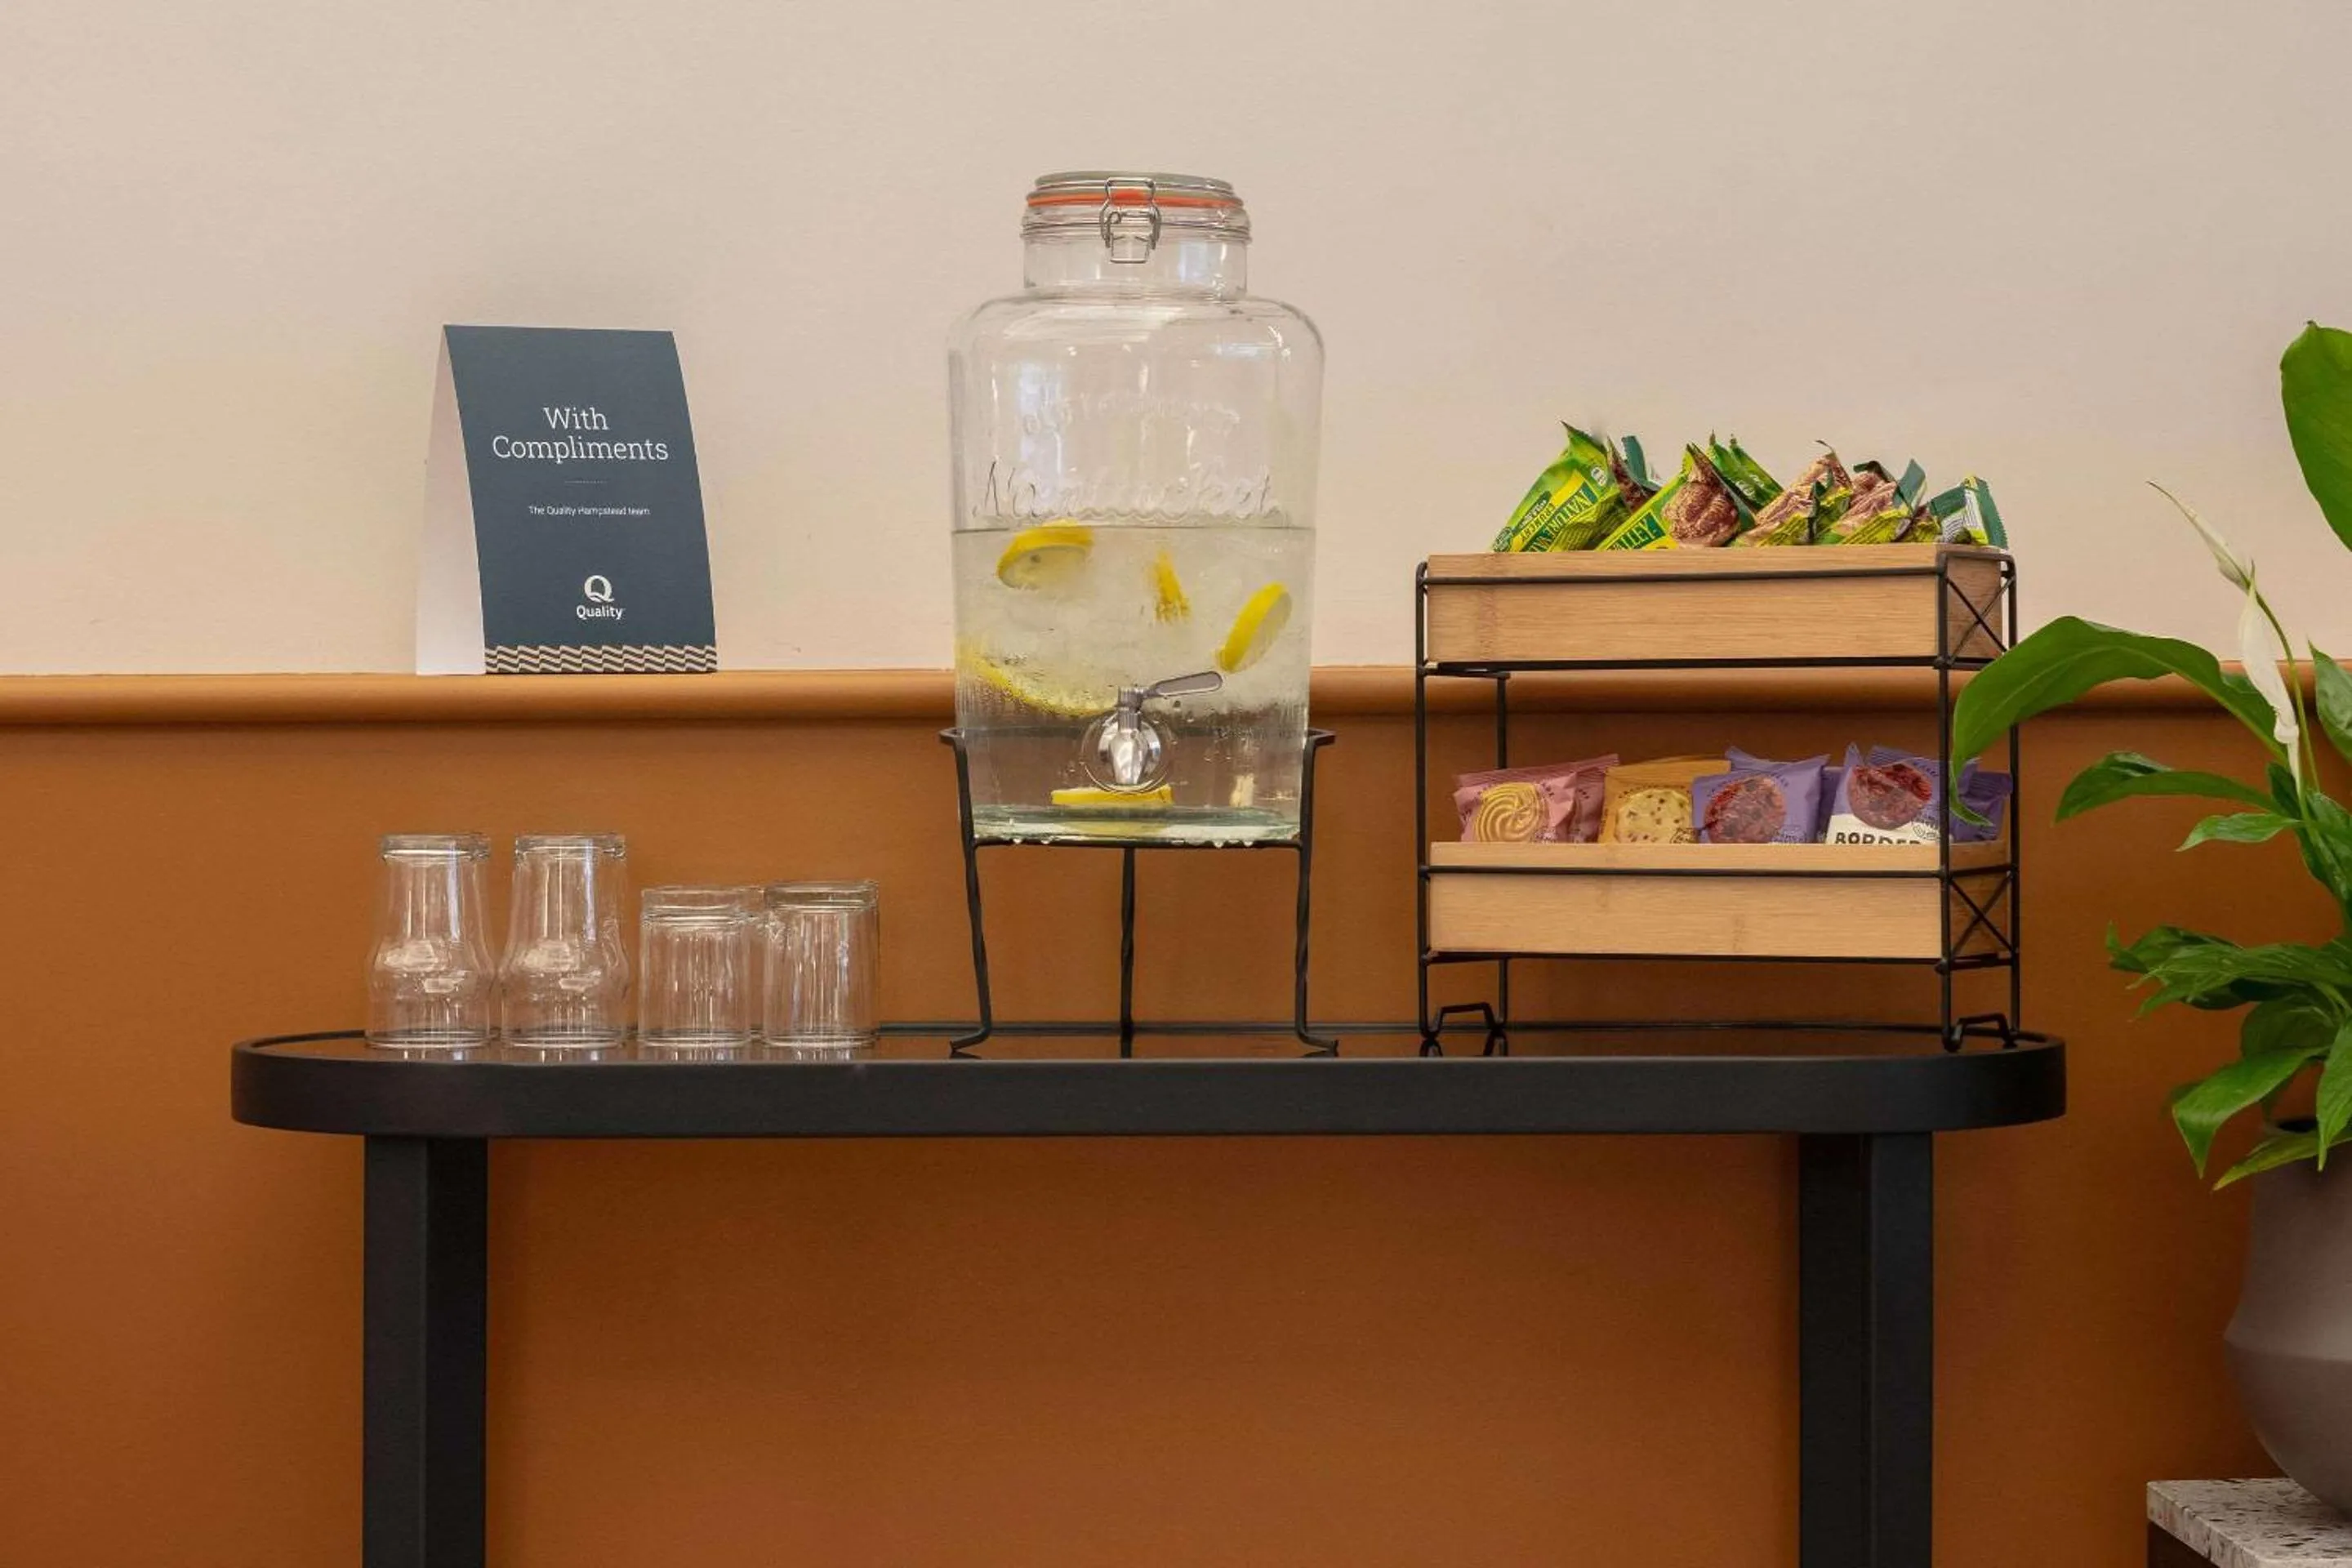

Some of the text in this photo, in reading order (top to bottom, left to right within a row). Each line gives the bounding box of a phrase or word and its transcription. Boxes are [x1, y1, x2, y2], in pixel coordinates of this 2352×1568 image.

[543, 407, 609, 430] With
[492, 435, 669, 464] Compliments
[528, 506, 651, 519] The Quality Hampstead team
[1519, 501, 1557, 542] CRUNCHY
[1541, 488, 1596, 539] NATURE
[1612, 518, 1656, 551] ALLEY
[584, 575, 615, 603] Q
[577, 604, 623, 620] Quality
[1834, 832, 1921, 844] BOR
